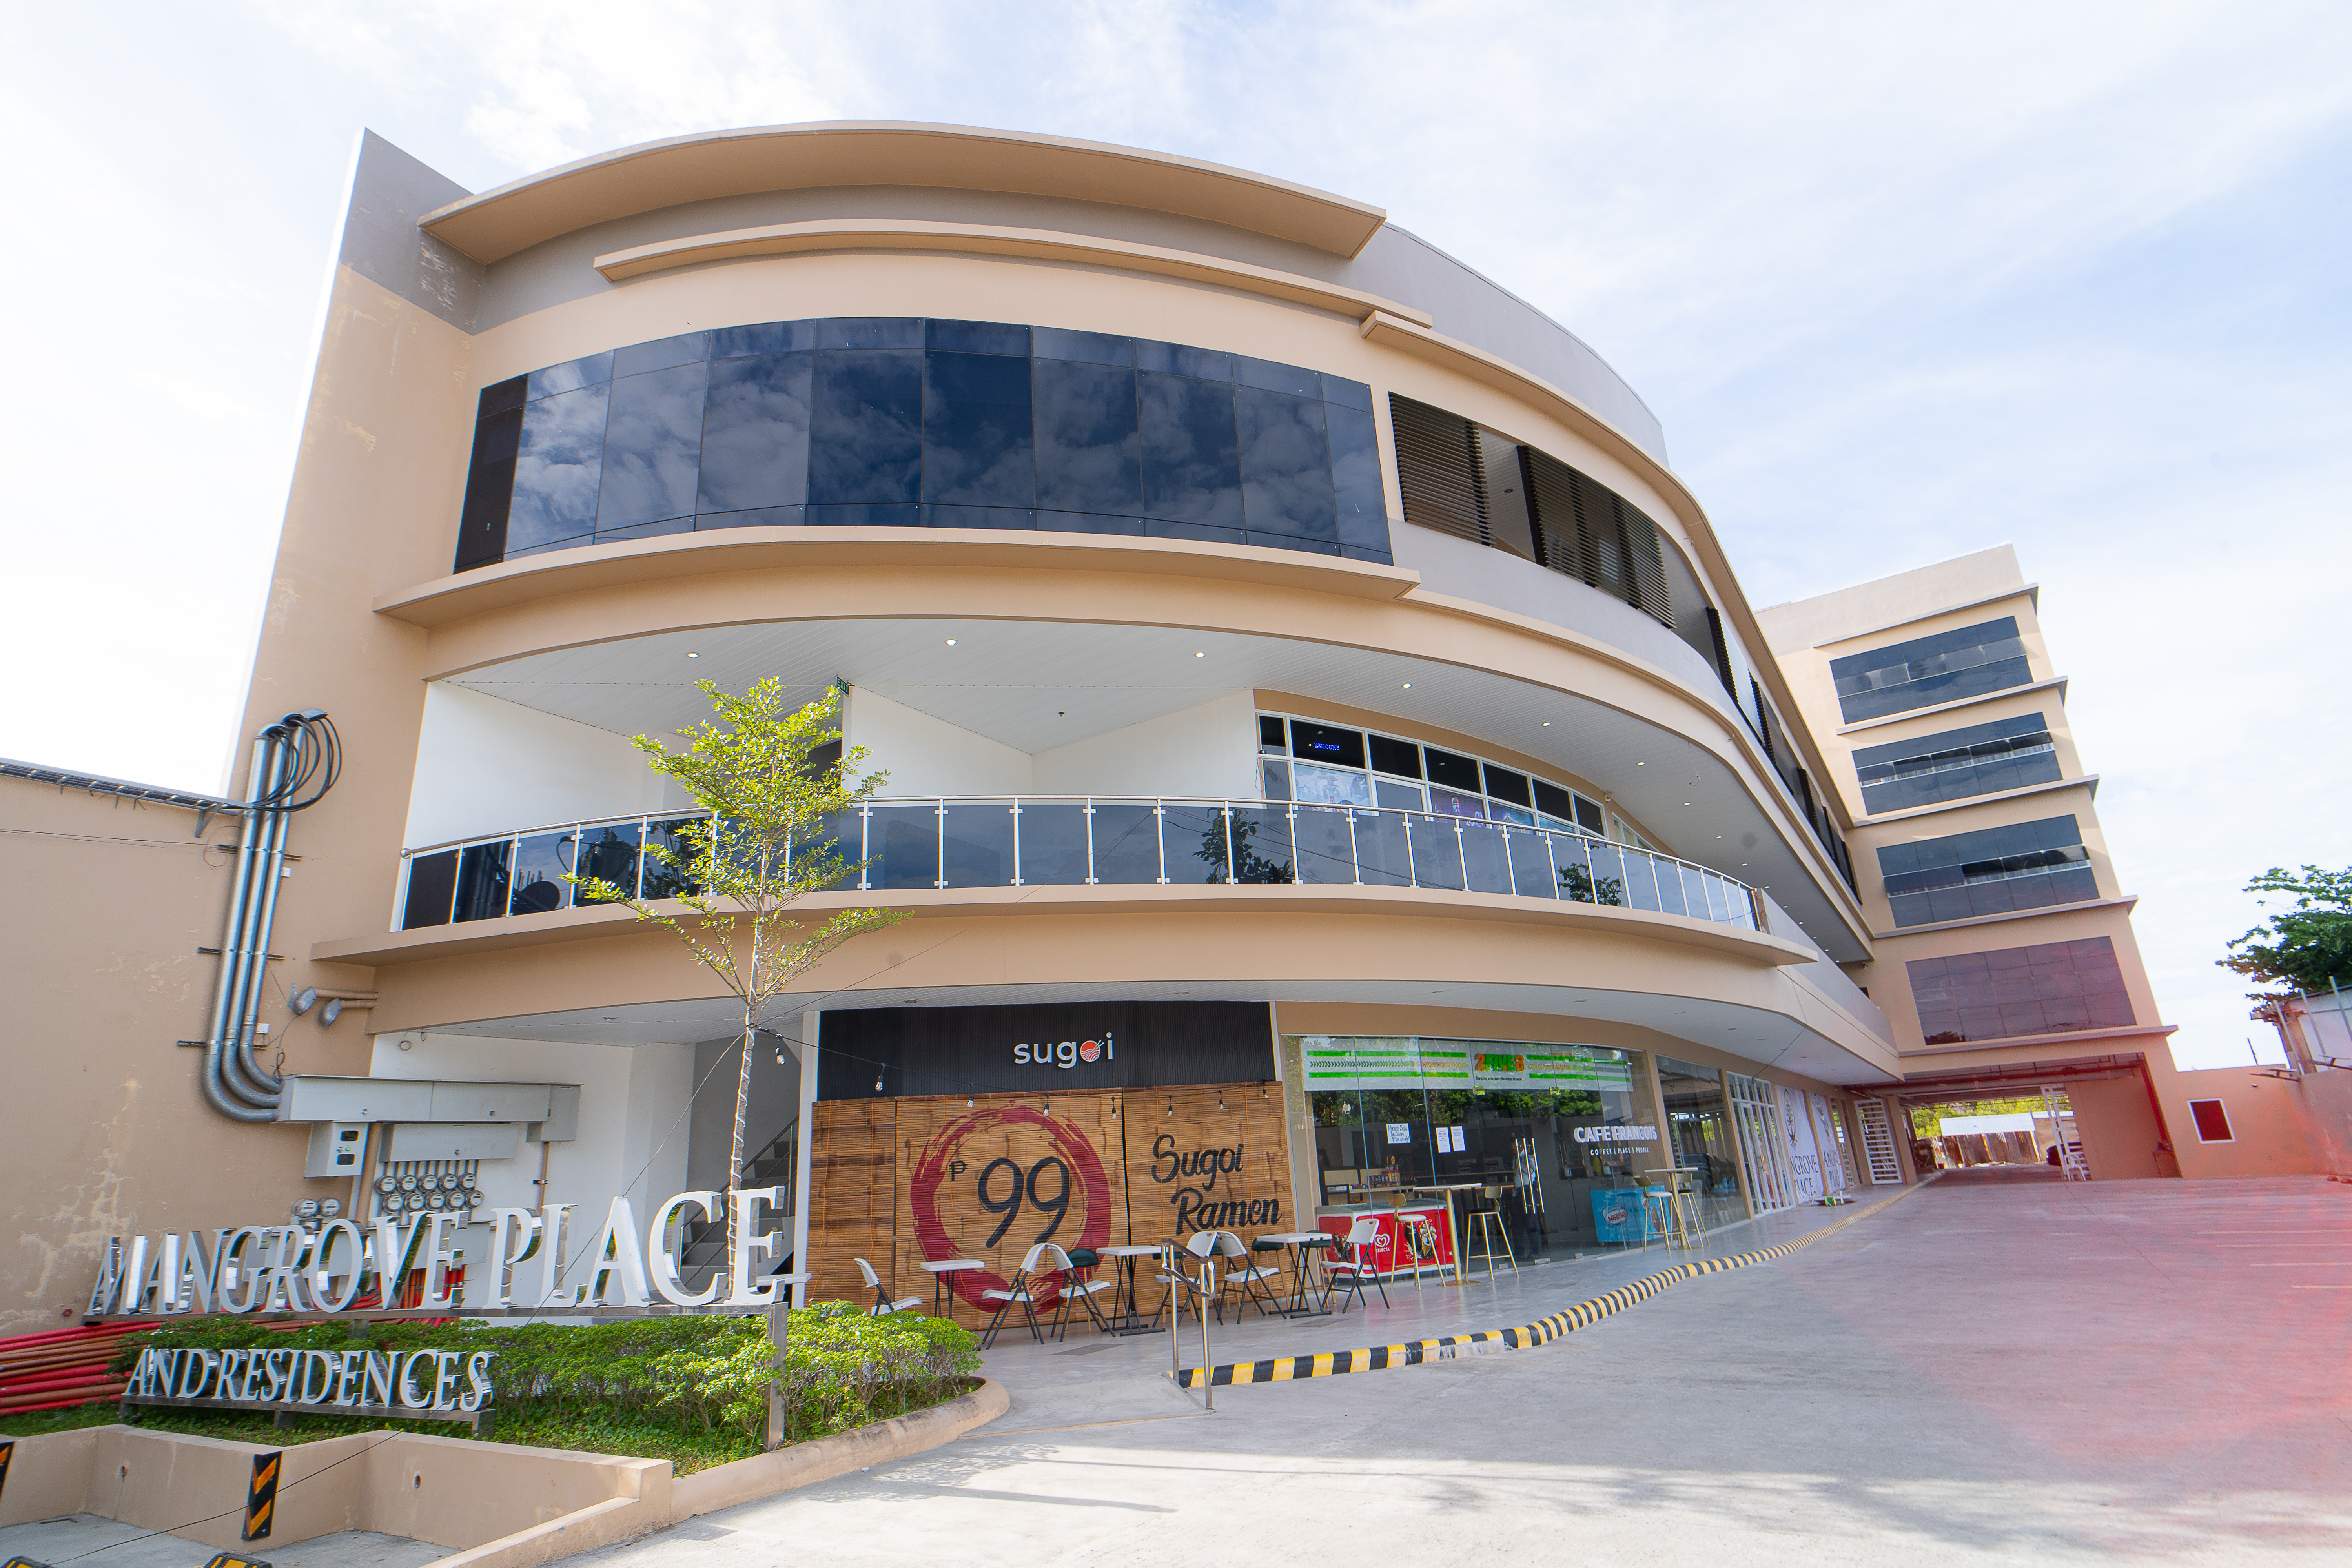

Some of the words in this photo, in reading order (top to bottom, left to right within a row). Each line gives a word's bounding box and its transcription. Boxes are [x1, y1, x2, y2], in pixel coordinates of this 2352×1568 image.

[1314, 742, 1340, 750] WELCOME
[1014, 1032, 1113, 1068] sugoi
[1574, 1126, 1612, 1143] CAFE
[1611, 1125, 1658, 1140] FRANCOIS
[1151, 1134, 1244, 1192] Sugoi
[977, 1156, 1071, 1248] 99
[1170, 1187, 1283, 1236] Ramen
[83, 1210, 467, 1315] MANGROVE
[482, 1186, 782, 1309] PLACE
